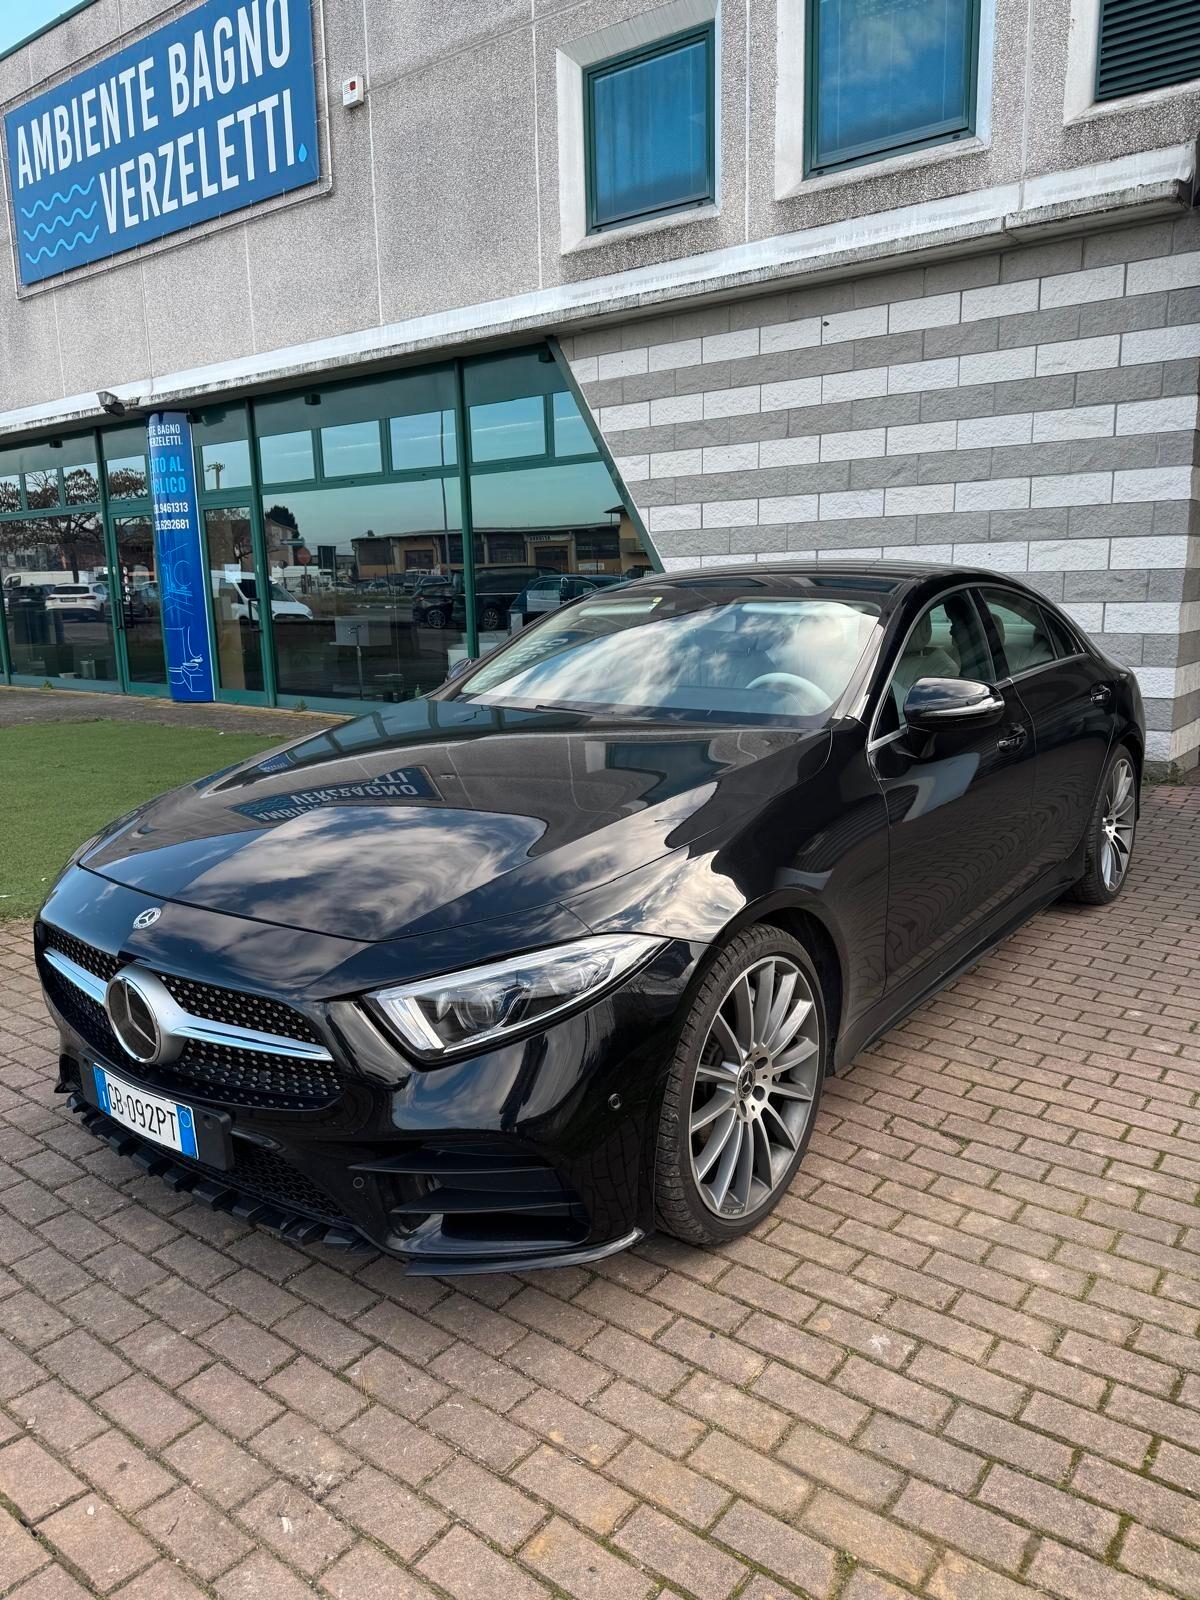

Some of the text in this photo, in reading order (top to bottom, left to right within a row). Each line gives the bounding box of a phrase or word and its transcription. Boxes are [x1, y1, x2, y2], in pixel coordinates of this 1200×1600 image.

[17, 0, 290, 190] AMBIENTE BAGNO
[157, 423, 180, 435] BAGNO
[169, 456, 184, 472] AL
[107, 1083, 176, 1142] GB092PT
